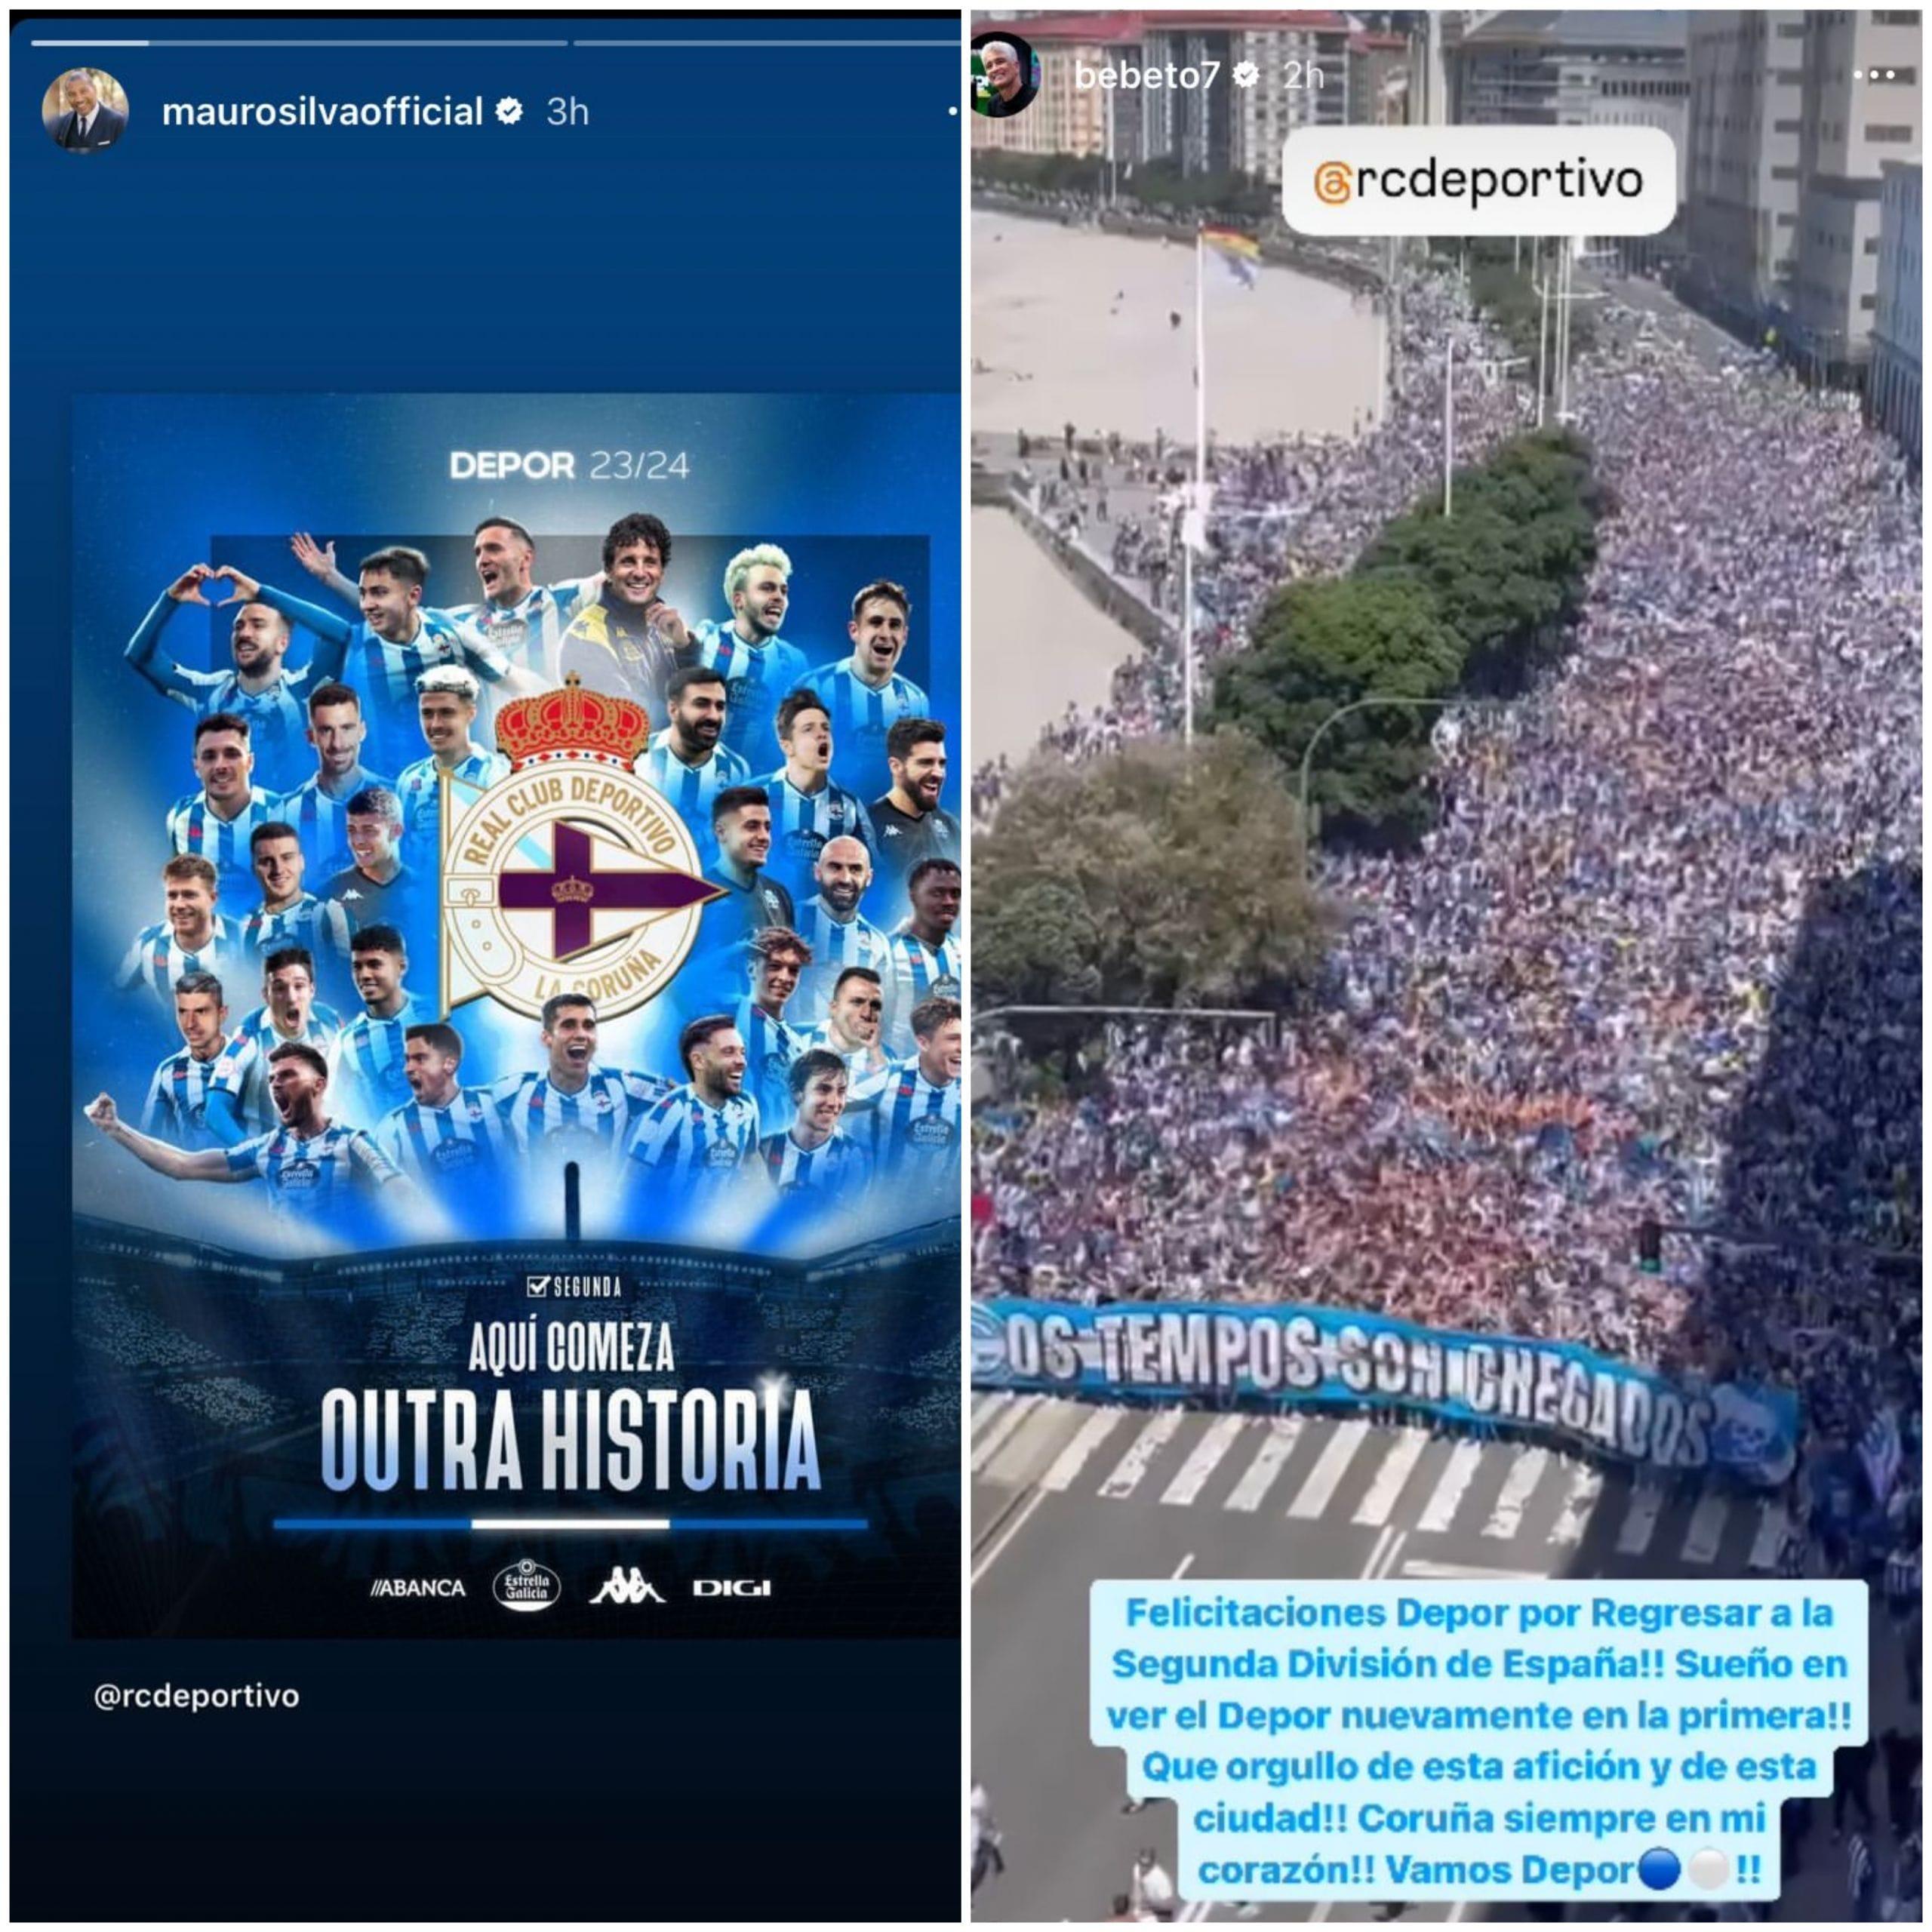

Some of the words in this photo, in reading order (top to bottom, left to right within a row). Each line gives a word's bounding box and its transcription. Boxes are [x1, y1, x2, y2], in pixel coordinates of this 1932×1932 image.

[450, 451, 575, 480] DEPOR
[589, 451, 690, 481] 23/24
[464, 810, 511, 866] REAL
[507, 777, 564, 817] CLUB
[571, 776, 677, 856] DEPORTIVO
[553, 1275, 622, 1297] SEGUNDA
[469, 1313, 537, 1377] AQUÍ
[547, 1321, 675, 1372] COMEZA
[1006, 1312, 1077, 1379] OS
[1094, 1313, 1318, 1389] TEMPOS
[1464, 1343, 1712, 1468] CHEGADOS
[321, 1387, 524, 1492] OUTRA
[543, 1386, 821, 1492] HISTORIA
[504, 1574, 550, 1587] Estrella
[506, 1587, 548, 1600] Galicia
[693, 1580, 771, 1596] DIGI
